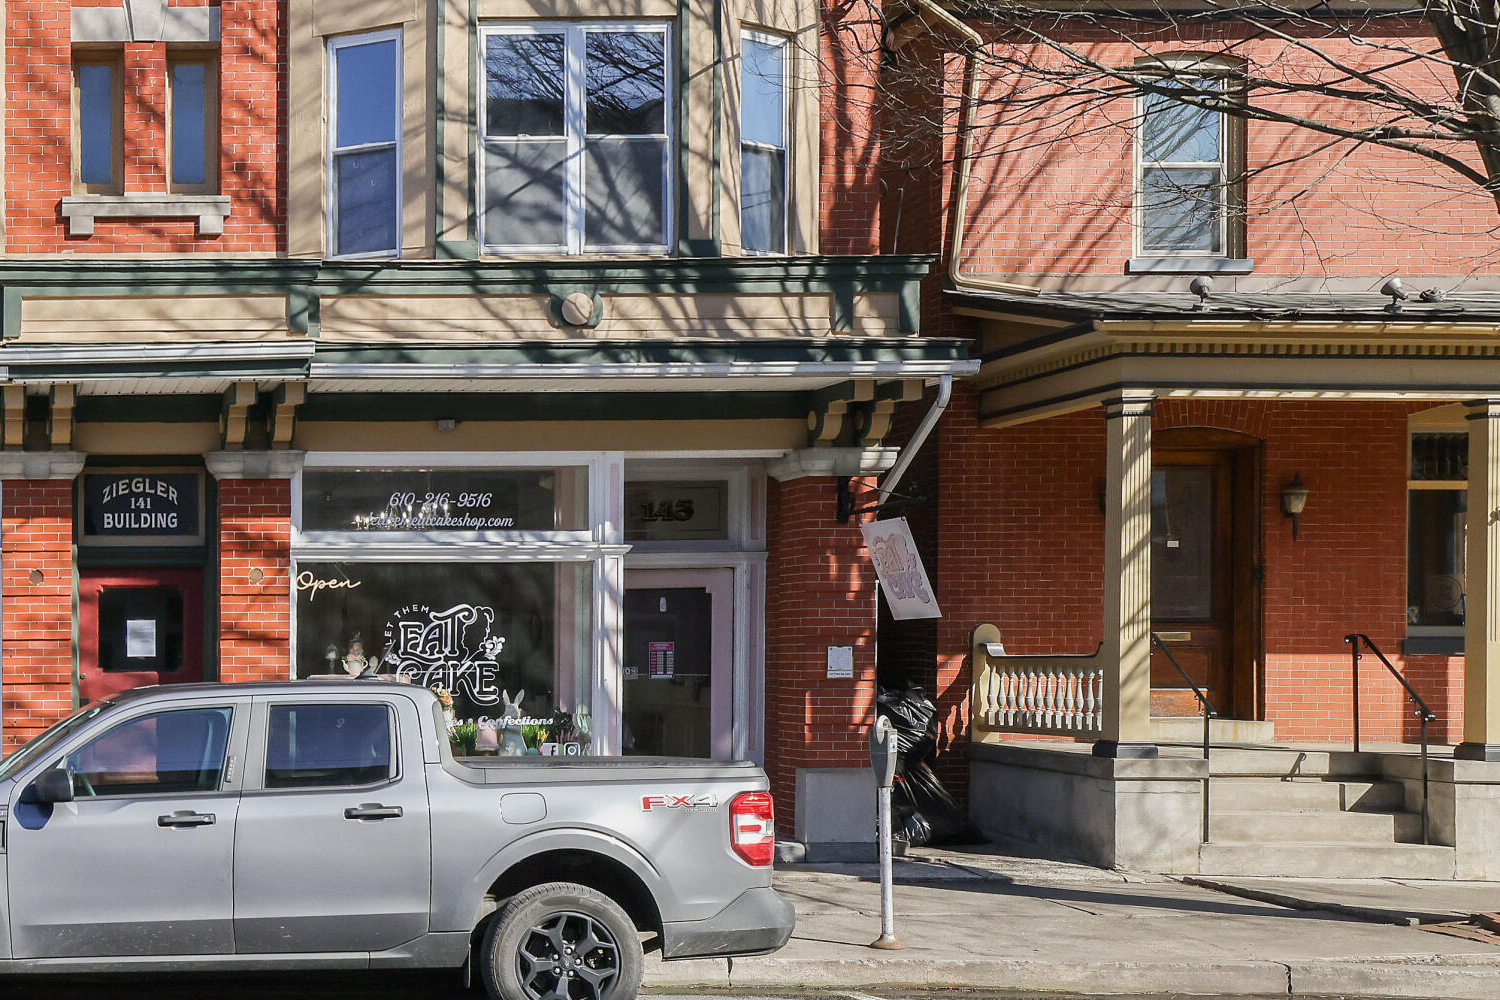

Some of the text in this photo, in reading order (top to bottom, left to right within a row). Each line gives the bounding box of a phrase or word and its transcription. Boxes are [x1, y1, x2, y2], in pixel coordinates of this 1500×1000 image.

[102, 478, 178, 505] ZIEGLER
[389, 492, 493, 508] 610-216-9516
[130, 497, 151, 509] 141
[103, 512, 178, 529] BUILDING
[296, 570, 361, 602] Open
[384, 604, 429, 646] LET THEM
[398, 603, 477, 663] EAT
[396, 660, 500, 706] CAKE
[478, 715, 554, 729] Confections
[642, 795, 719, 812] FX4
